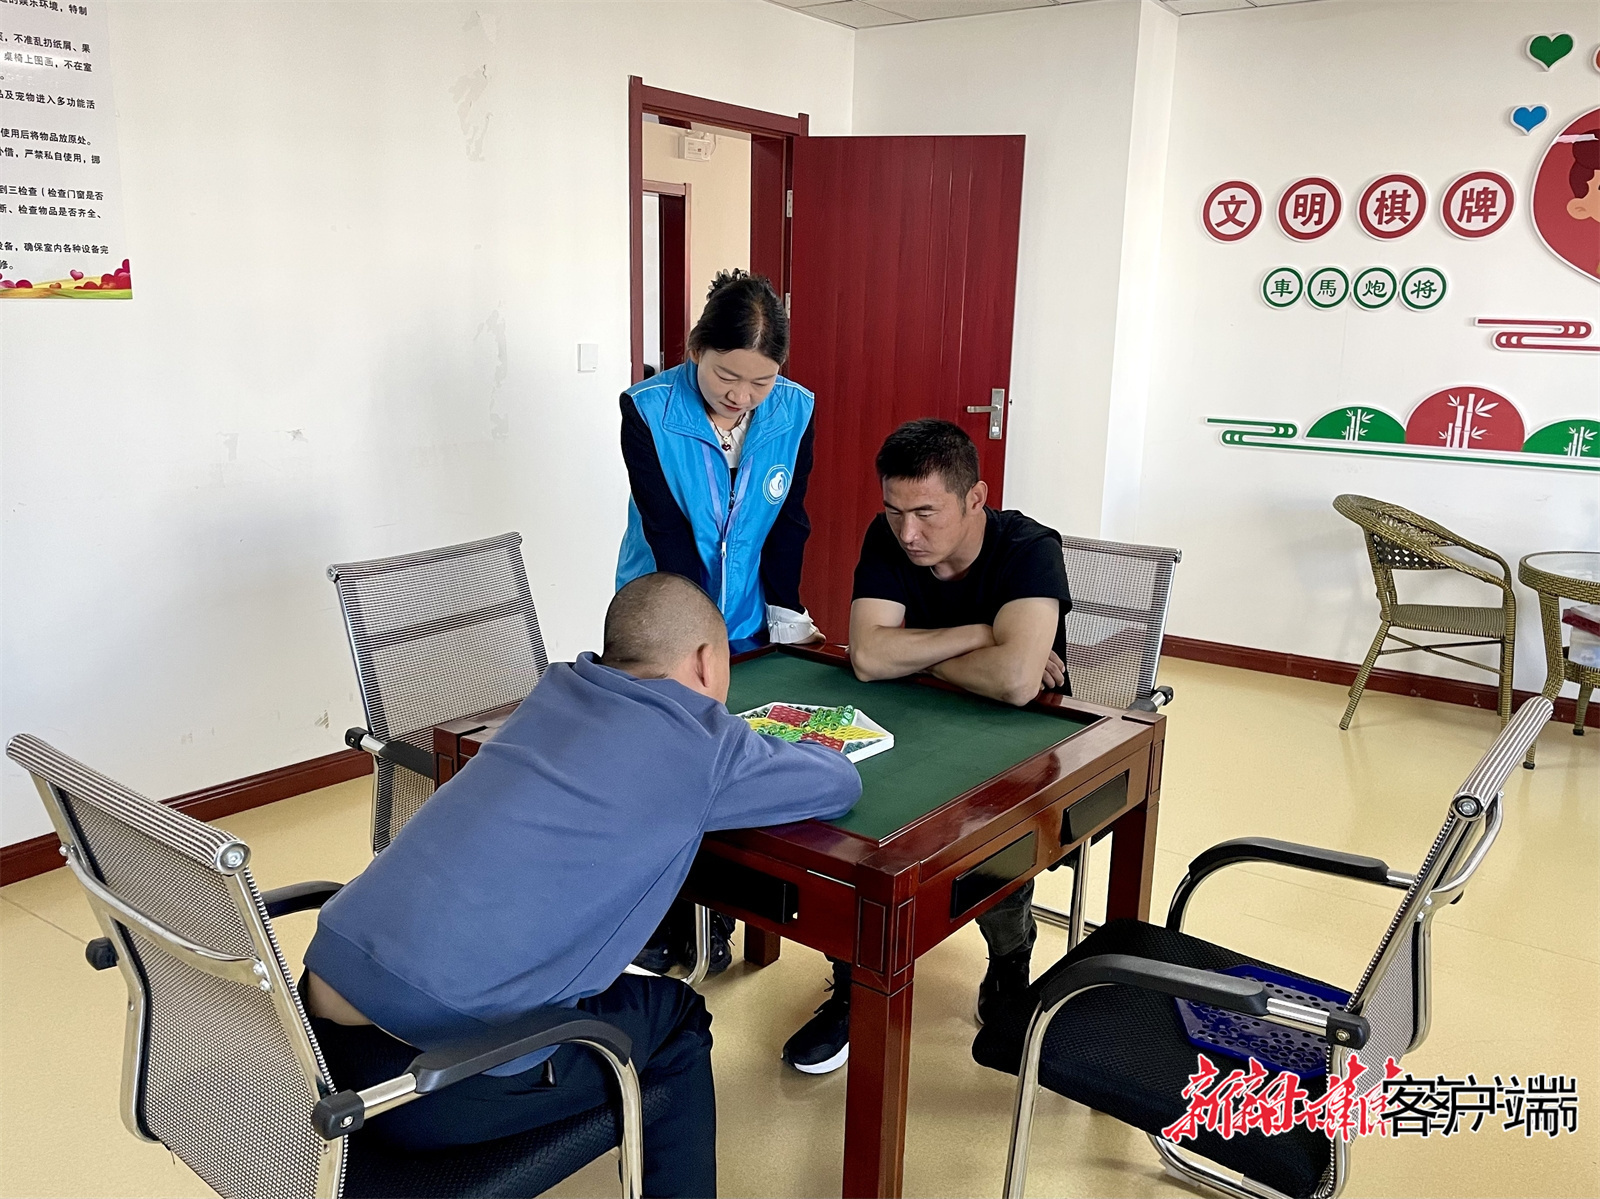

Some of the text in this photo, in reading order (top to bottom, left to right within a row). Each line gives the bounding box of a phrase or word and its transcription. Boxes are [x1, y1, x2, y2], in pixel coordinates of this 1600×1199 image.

[0, 127, 92, 146] 使用后将物品放原处。
[1215, 187, 1499, 229] 文明棋牌
